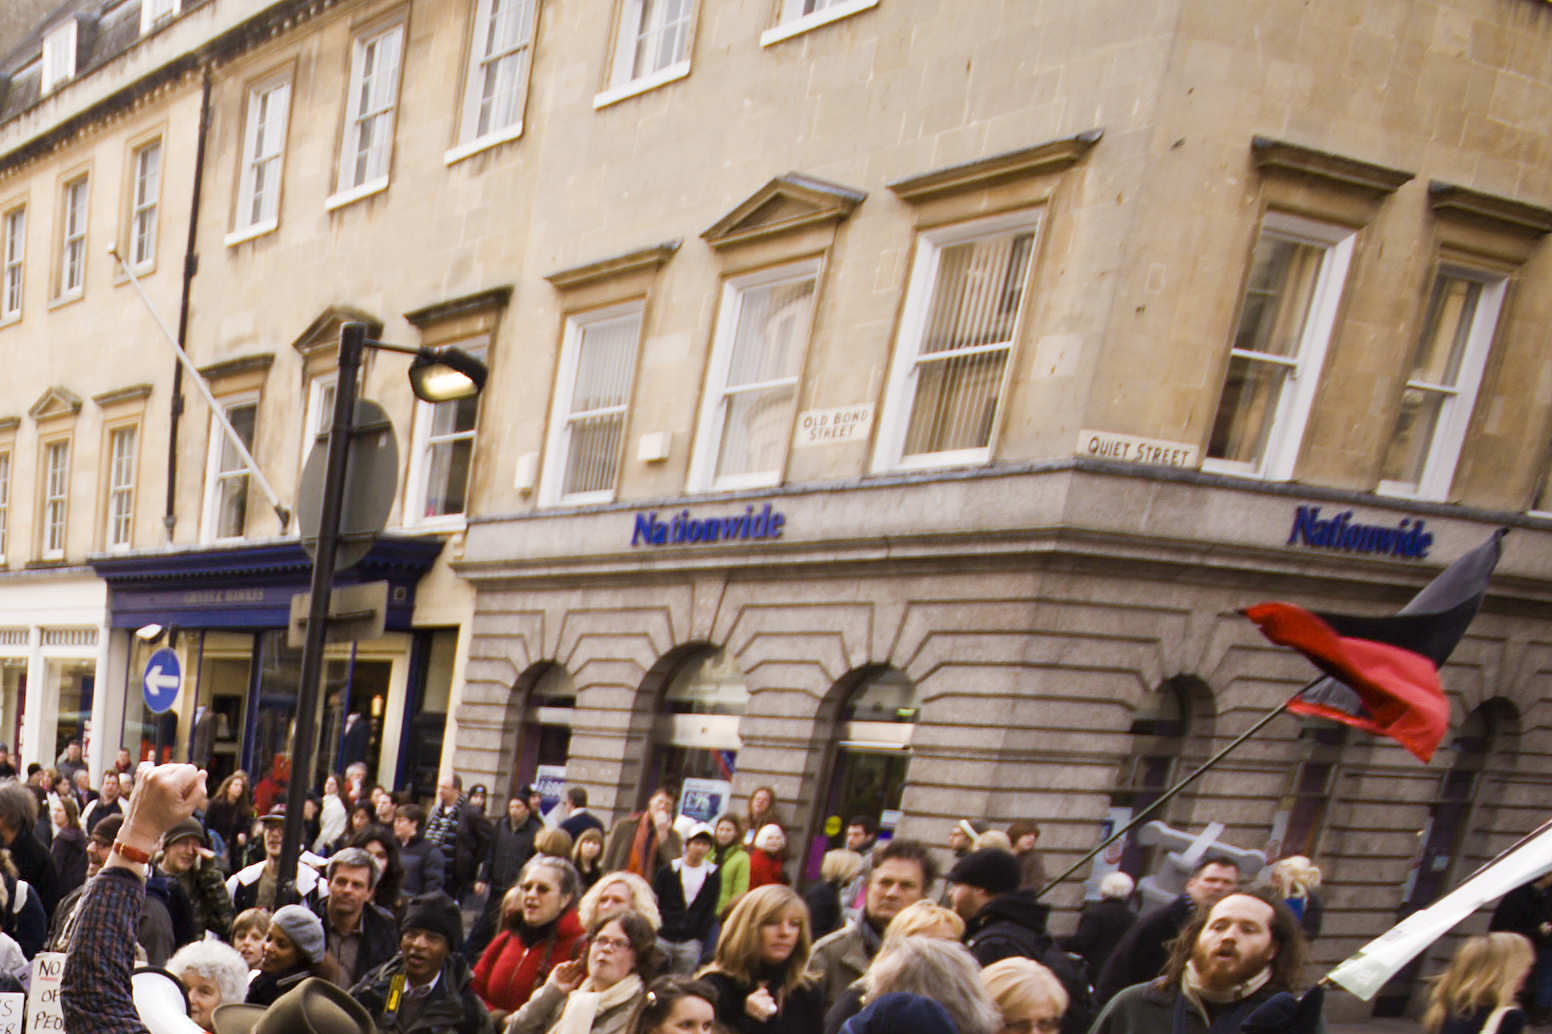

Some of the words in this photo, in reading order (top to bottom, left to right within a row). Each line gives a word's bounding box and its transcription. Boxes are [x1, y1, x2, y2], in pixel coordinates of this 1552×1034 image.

[804, 416, 828, 429] OLD
[834, 410, 868, 424] BOND
[809, 424, 855, 440] STREET
[1088, 436, 1130, 459] QUIET
[1137, 444, 1190, 466] STREET
[631, 503, 786, 546] Nationwide
[1287, 505, 1434, 558] Nationwide
[38, 960, 60, 976] NO
[34, 1011, 64, 1030] PEO
